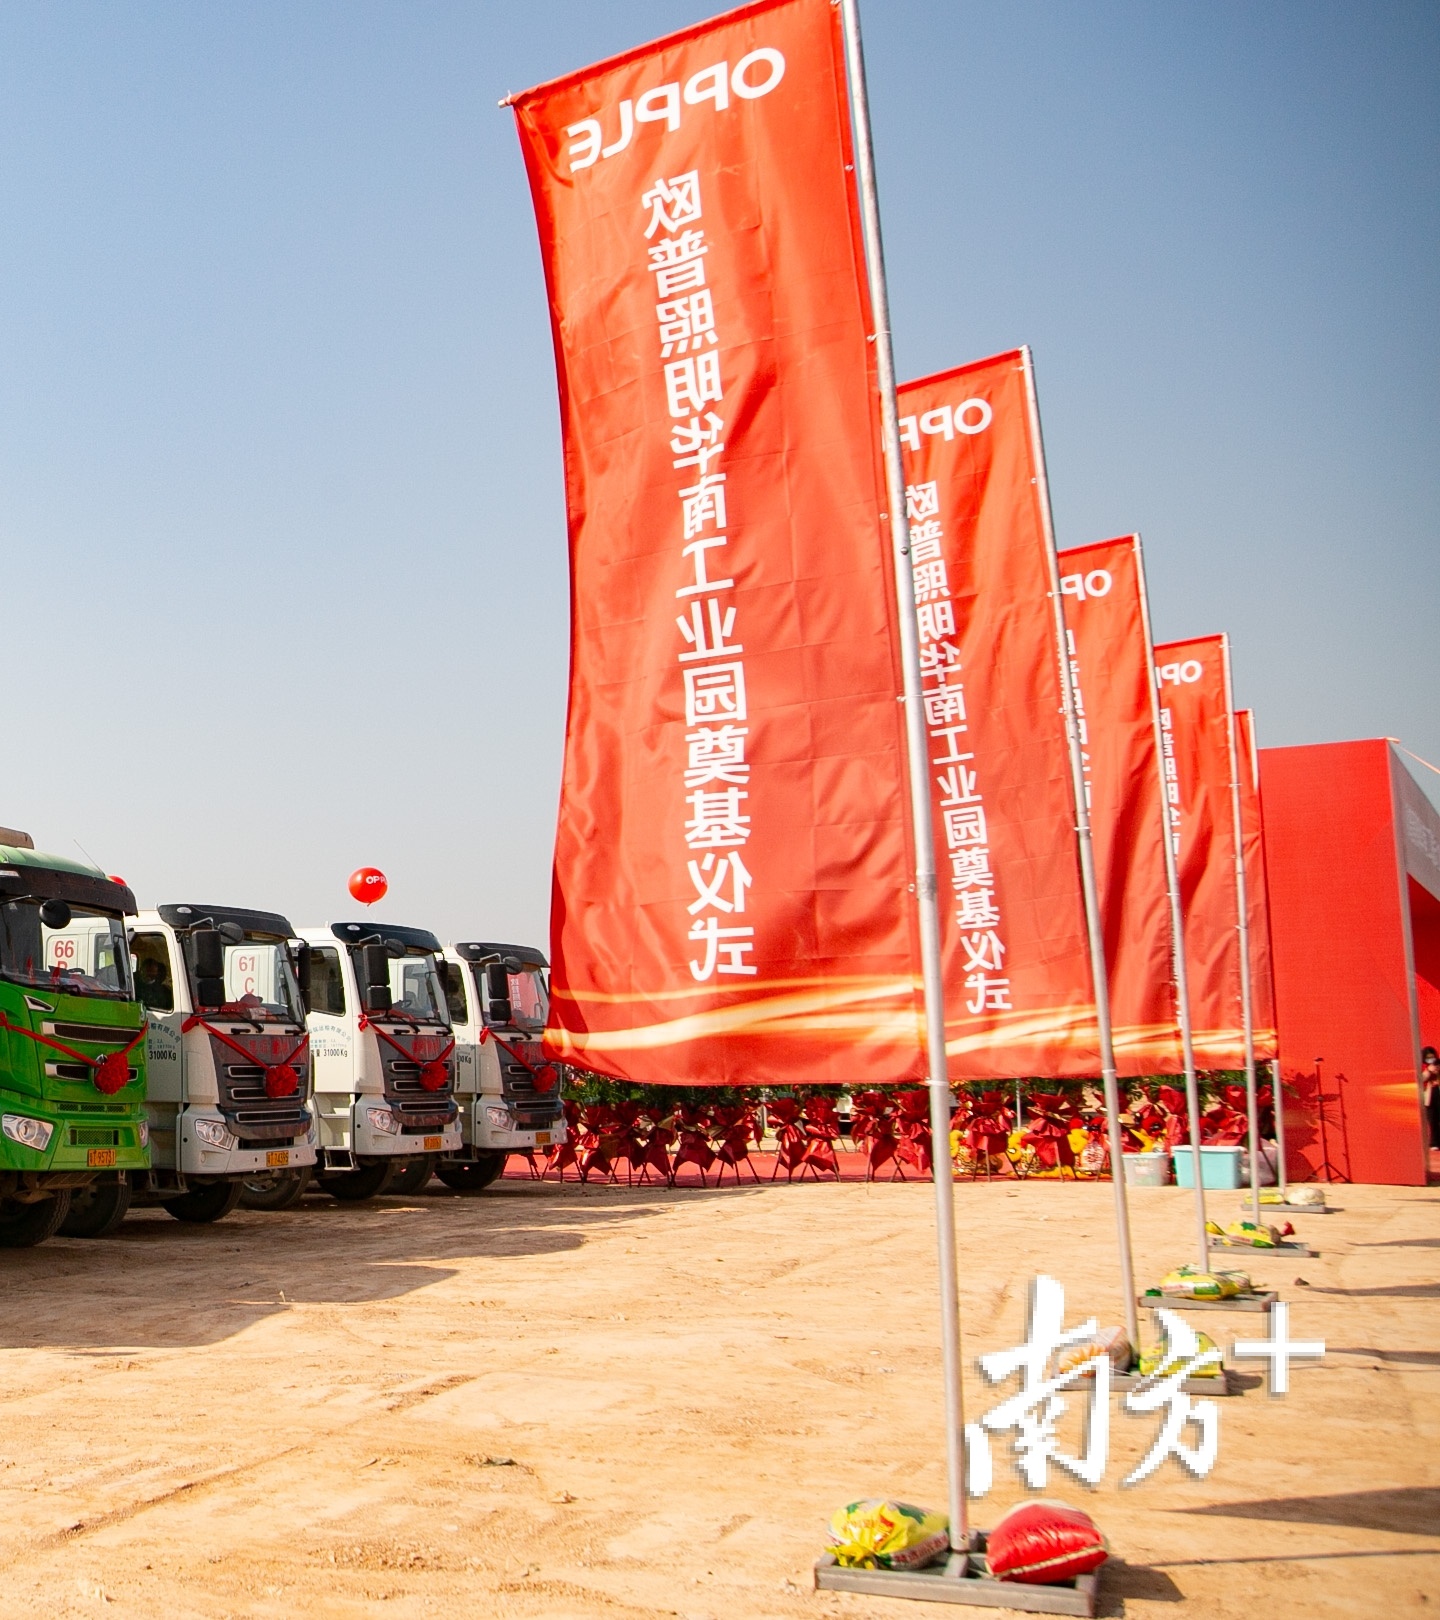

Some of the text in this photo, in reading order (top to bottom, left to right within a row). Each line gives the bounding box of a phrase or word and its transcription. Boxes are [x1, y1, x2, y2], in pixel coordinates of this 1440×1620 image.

[365, 875, 387, 885] OPP
[54, 940, 74, 958] 66
[238, 956, 255, 971] 61
[149, 1050, 177, 1061] 31000Kg
